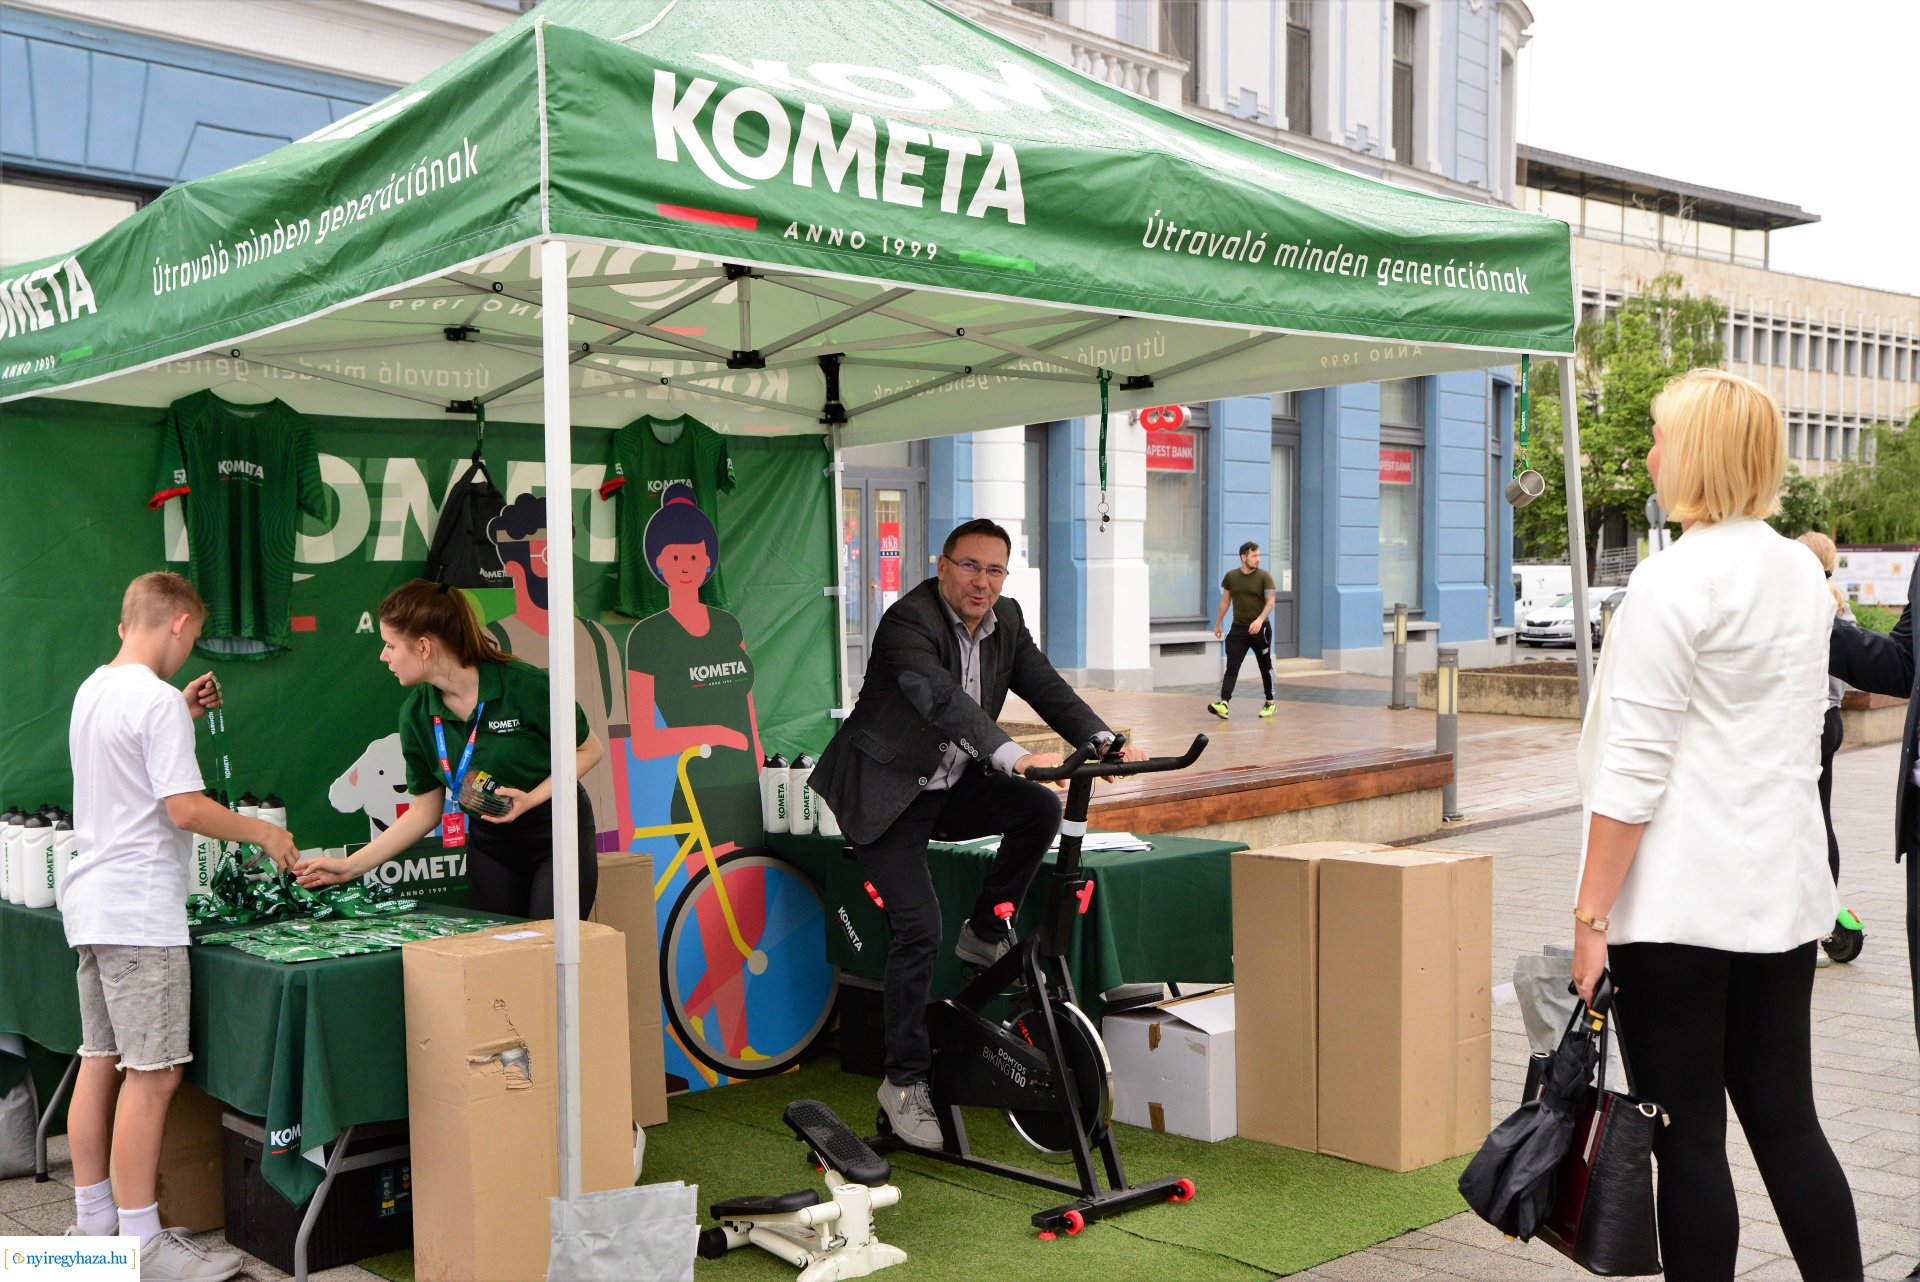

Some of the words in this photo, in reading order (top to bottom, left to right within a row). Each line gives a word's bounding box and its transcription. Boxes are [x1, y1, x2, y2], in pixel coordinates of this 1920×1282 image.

[652, 69, 1026, 226] KOMETA
[783, 221, 866, 250] ANNO
[882, 235, 938, 260] 1999
[1141, 209, 1268, 264] Útravaló
[1273, 239, 1369, 278] minden
[1376, 258, 1530, 295] generációnak
[152, 239, 230, 296] Útravaló
[234, 218, 311, 269] minden
[2, 363, 32, 379] ANNO
[1147, 444, 1171, 457] APEST
[1171, 446, 1194, 459] BANK
[218, 460, 264, 480] KOMETA
[689, 660, 747, 682] KOMETA
[488, 718, 520, 730] KOMETA
[223, 754, 231, 779] KOMETA
[778, 783, 786, 819] KOMETA
[803, 784, 811, 821] KOMETA
[46, 845, 55, 889] KOMETA
[197, 842, 208, 887] KOMETA
[401, 889, 425, 898] ANNO
[428, 886, 448, 895] 1999
[837, 906, 863, 952] KOMETA
[998, 1047, 1027, 1075] DOMYOS
[270, 1123, 302, 1147] KOM
